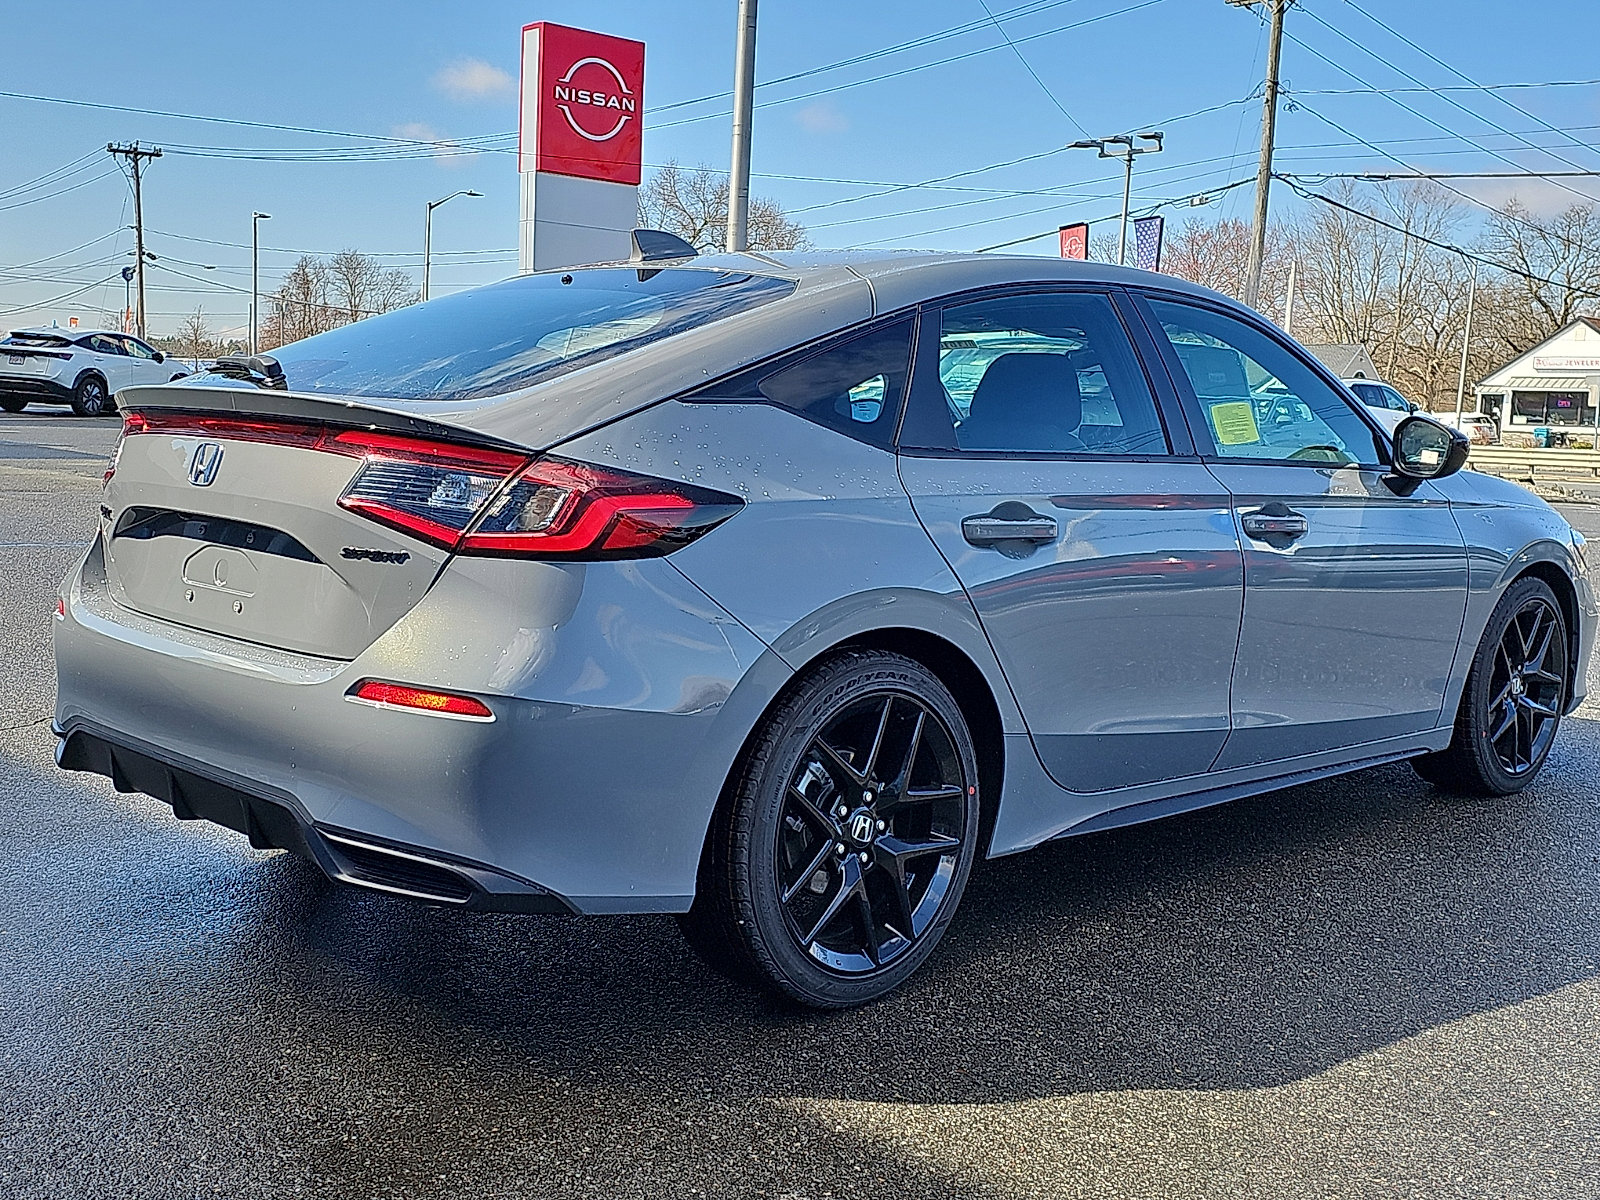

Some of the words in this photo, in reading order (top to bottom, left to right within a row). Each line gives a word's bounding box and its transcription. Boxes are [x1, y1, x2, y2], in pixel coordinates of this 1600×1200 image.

[555, 85, 635, 112] NISSAN
[340, 547, 411, 565] SPORT
[812, 671, 909, 716] GOODYEAR
